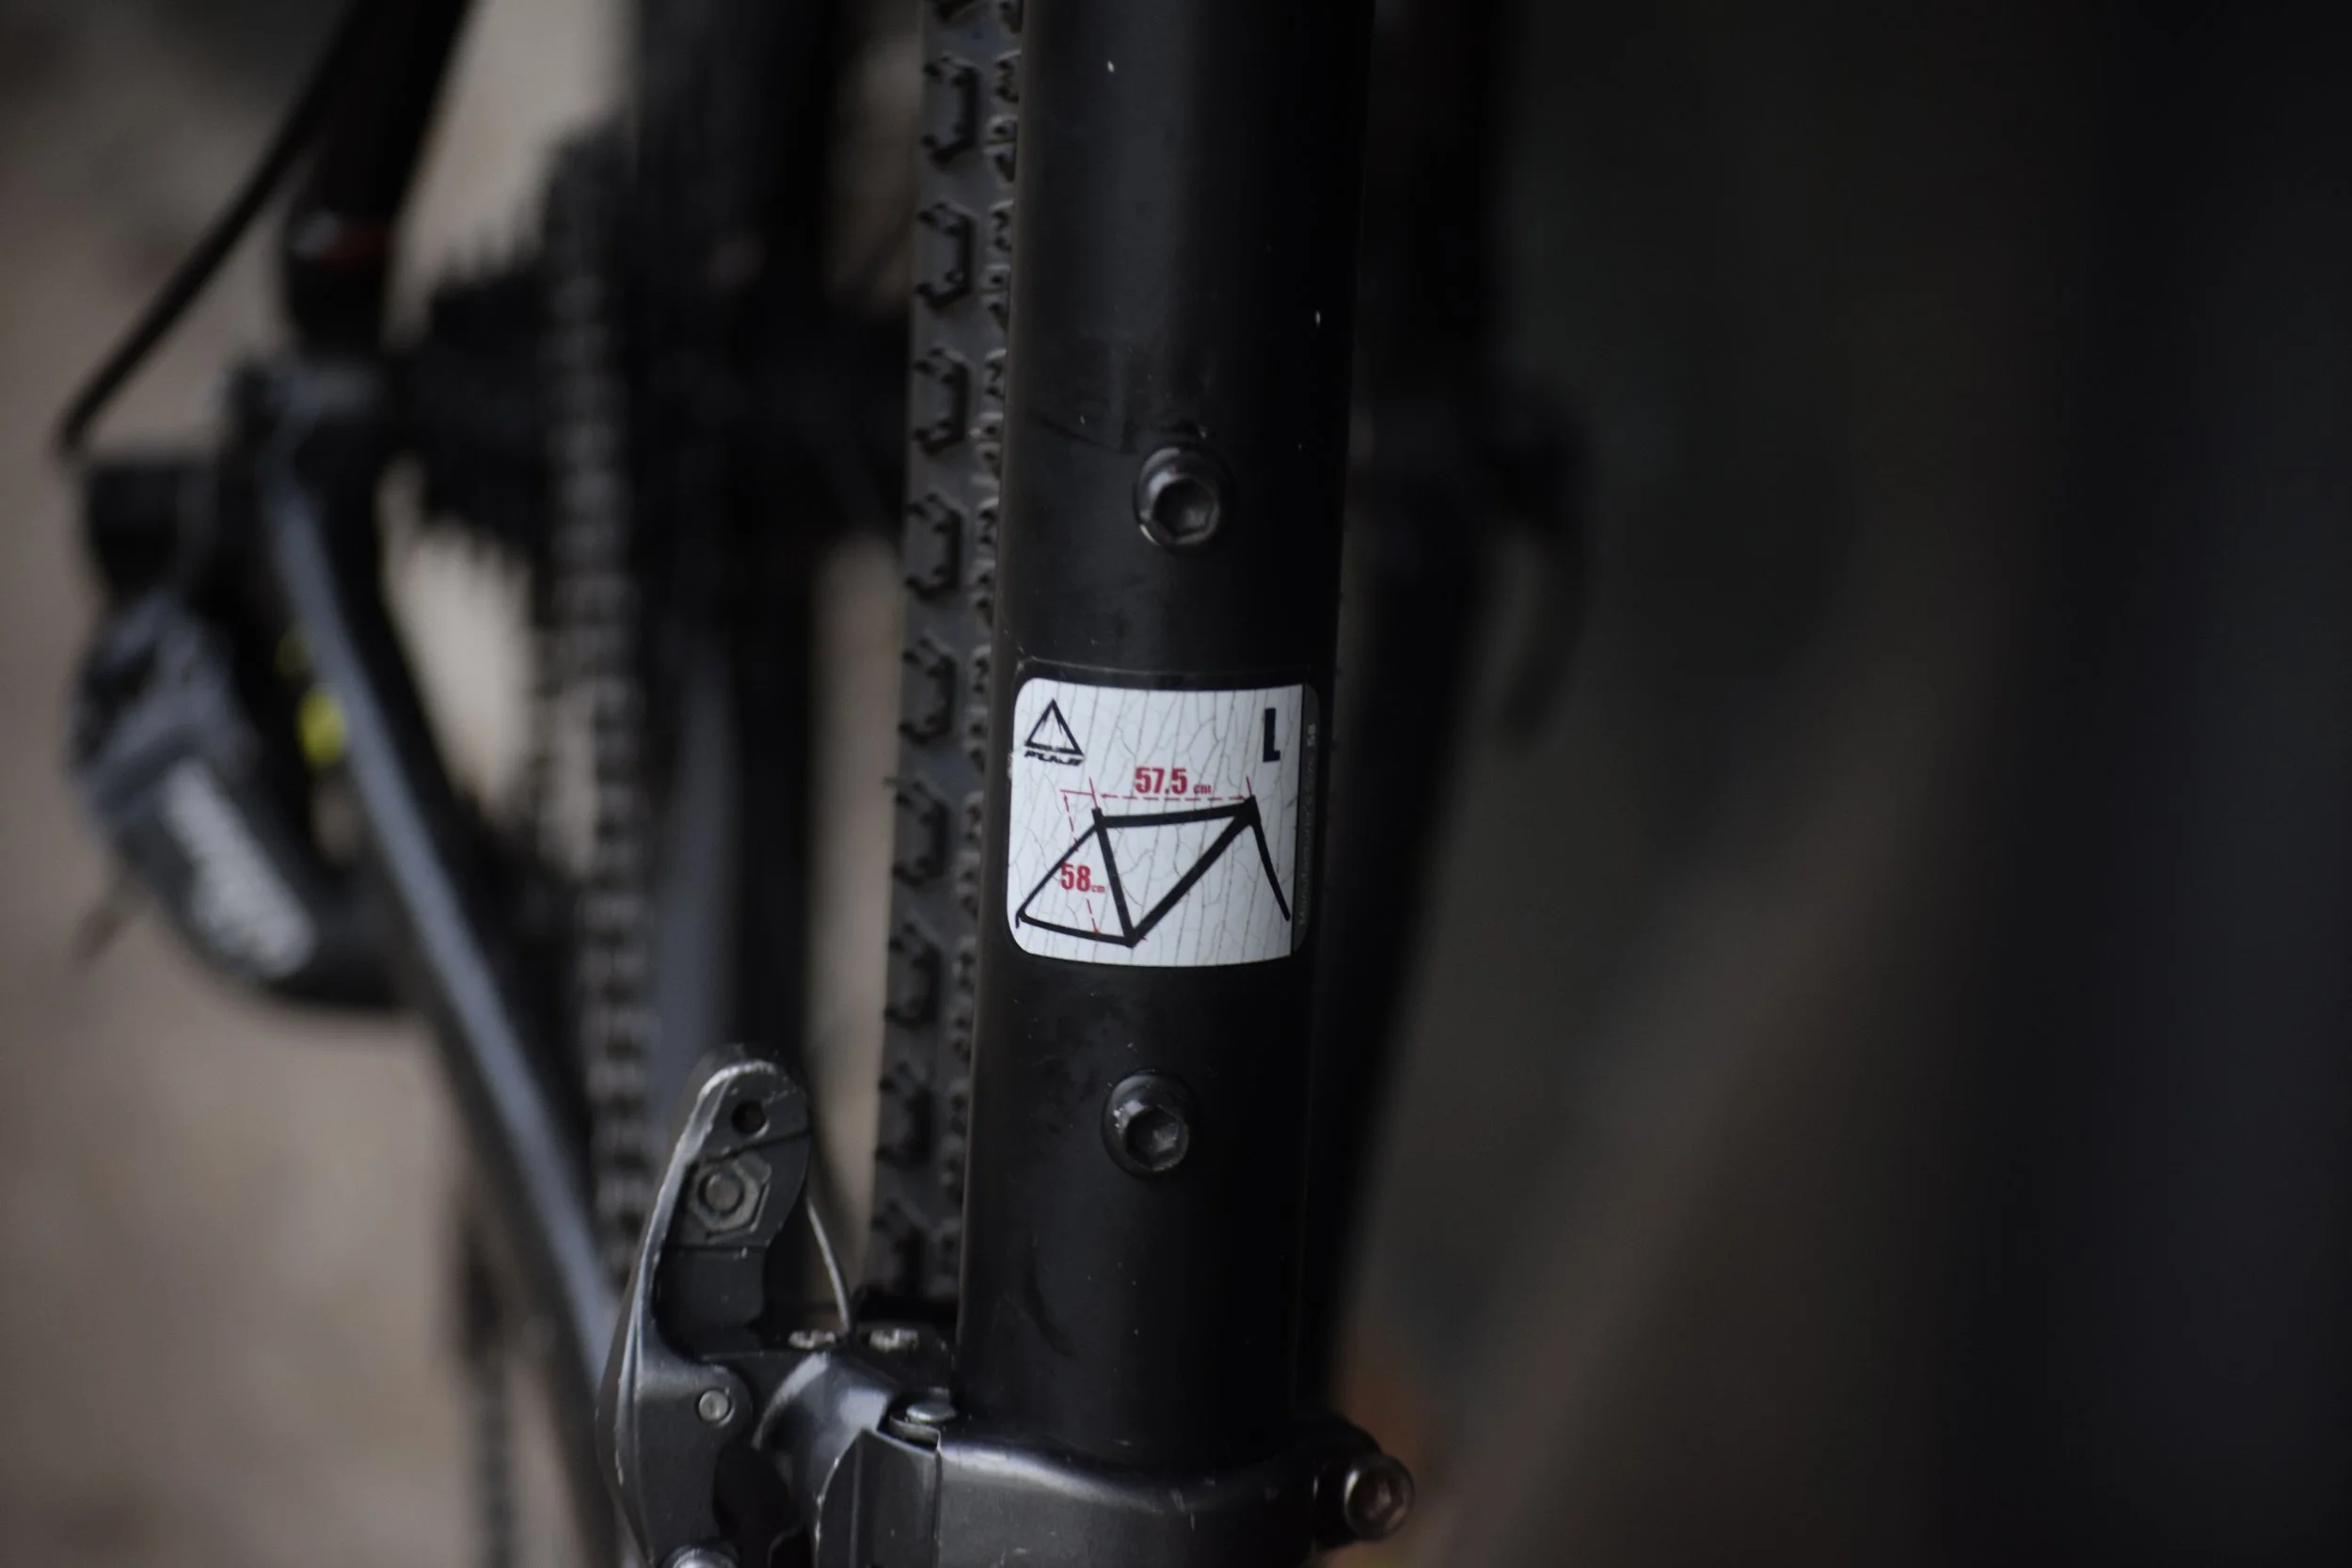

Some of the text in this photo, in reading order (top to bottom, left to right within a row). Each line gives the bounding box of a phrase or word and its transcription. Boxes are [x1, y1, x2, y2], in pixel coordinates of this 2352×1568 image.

[1263, 708, 1280, 762] L
[1135, 768, 1212, 795] 57.5 cm
[1060, 863, 1092, 893] 58
